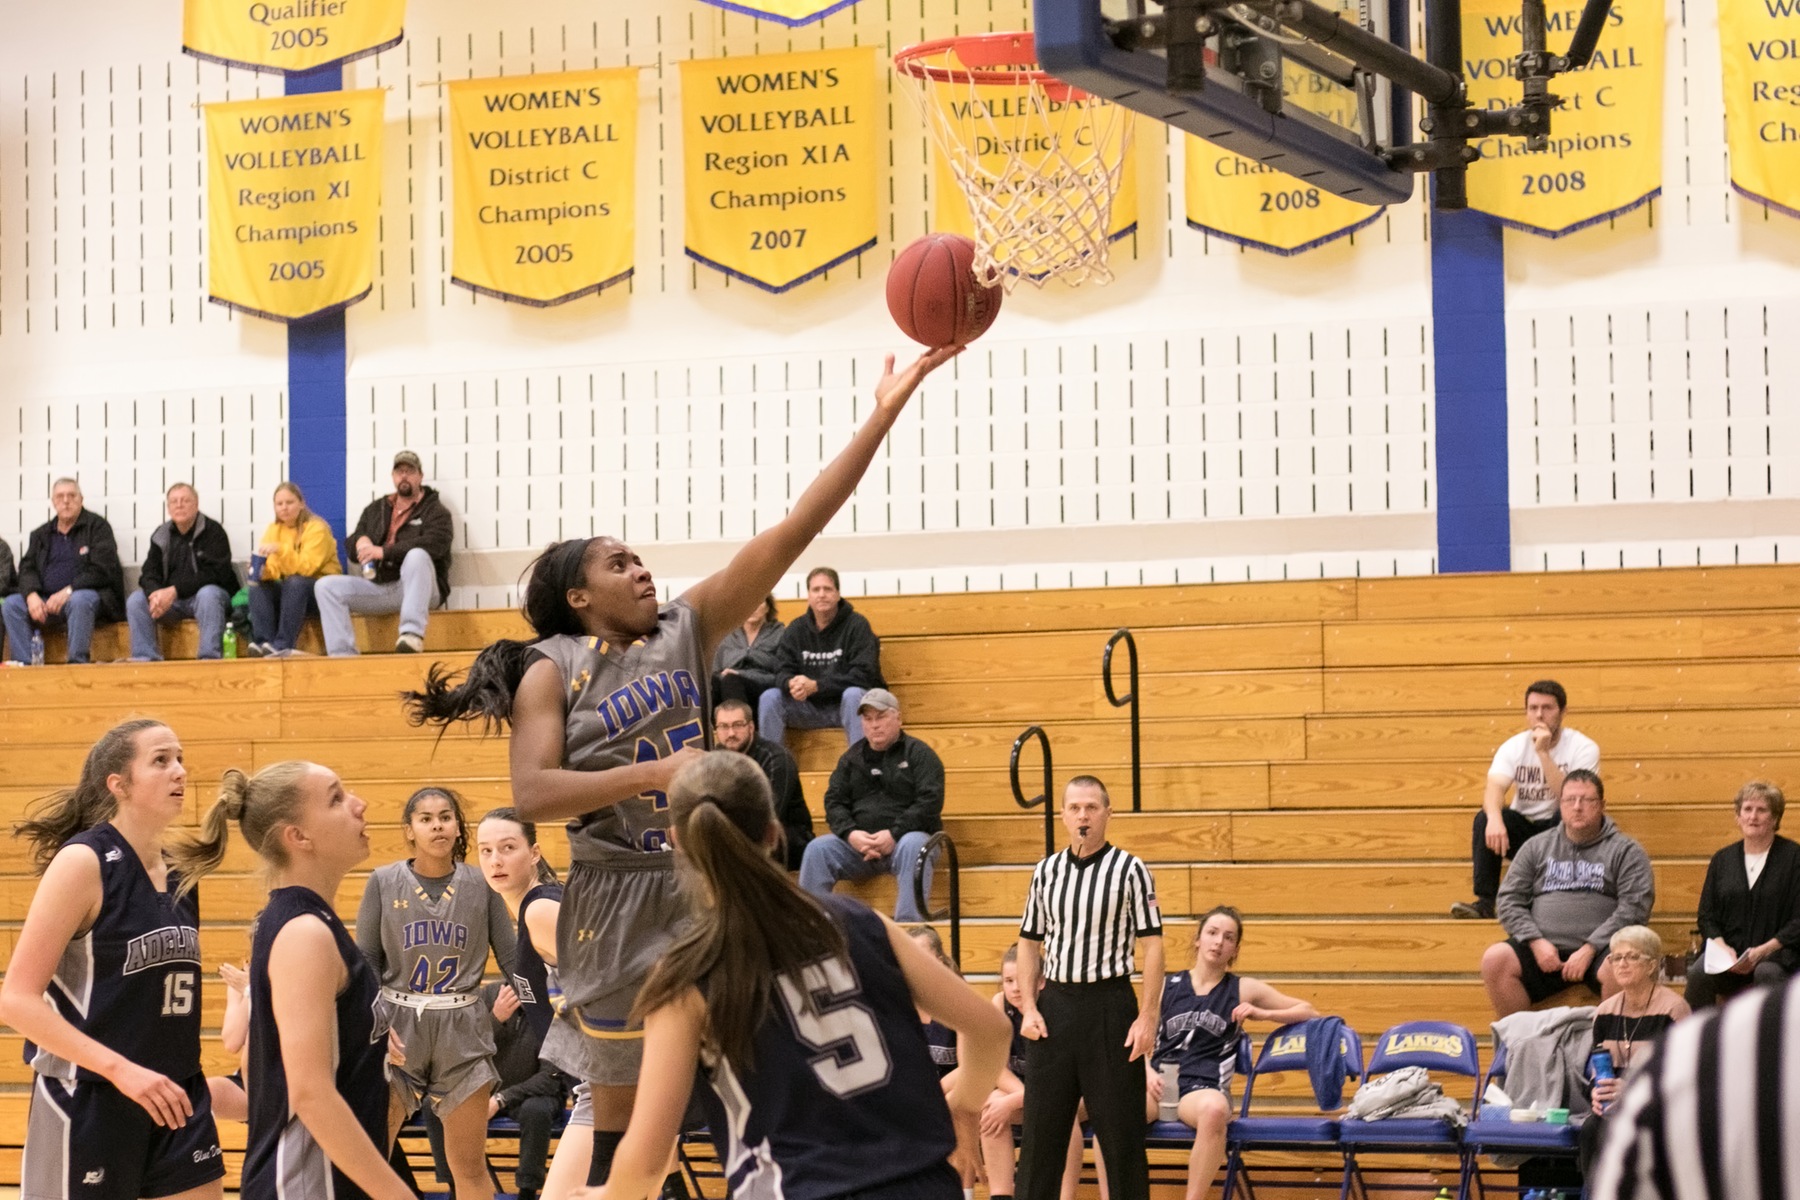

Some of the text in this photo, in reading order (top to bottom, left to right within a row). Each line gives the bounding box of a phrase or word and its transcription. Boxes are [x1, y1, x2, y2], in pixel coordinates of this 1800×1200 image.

[250, 0, 347, 25] Qualifier
[270, 27, 329, 51] 2005
[717, 68, 839, 95] WOMEN'S
[484, 87, 601, 113] WOMEN'S
[1596, 86, 1616, 108] C
[240, 108, 352, 135] WOMEN'S
[701, 105, 855, 134] VOLLEYBALL
[469, 124, 619, 150] VOLLEYBALL
[1074, 126, 1093, 146] C
[225, 143, 366, 171] VOLLEYBALL
[705, 144, 850, 175] Region XIA
[490, 161, 599, 187] District C
[1522, 170, 1586, 195] 2008
[239, 180, 350, 210] Region XI
[710, 187, 846, 211] Champions
[1260, 188, 1320, 212] 2008
[479, 202, 610, 225] Champions
[235, 220, 358, 244] Champions
[750, 229, 807, 251] 2007
[515, 243, 573, 265] 2005
[269, 260, 325, 281] 2005
[597, 669, 701, 742] IOWA
[403, 919, 468, 951] IOWA
[408, 954, 461, 995] 42
[161, 971, 195, 1017] 15
[775, 953, 894, 1100] 5
[1385, 1032, 1463, 1058] LAKERS
